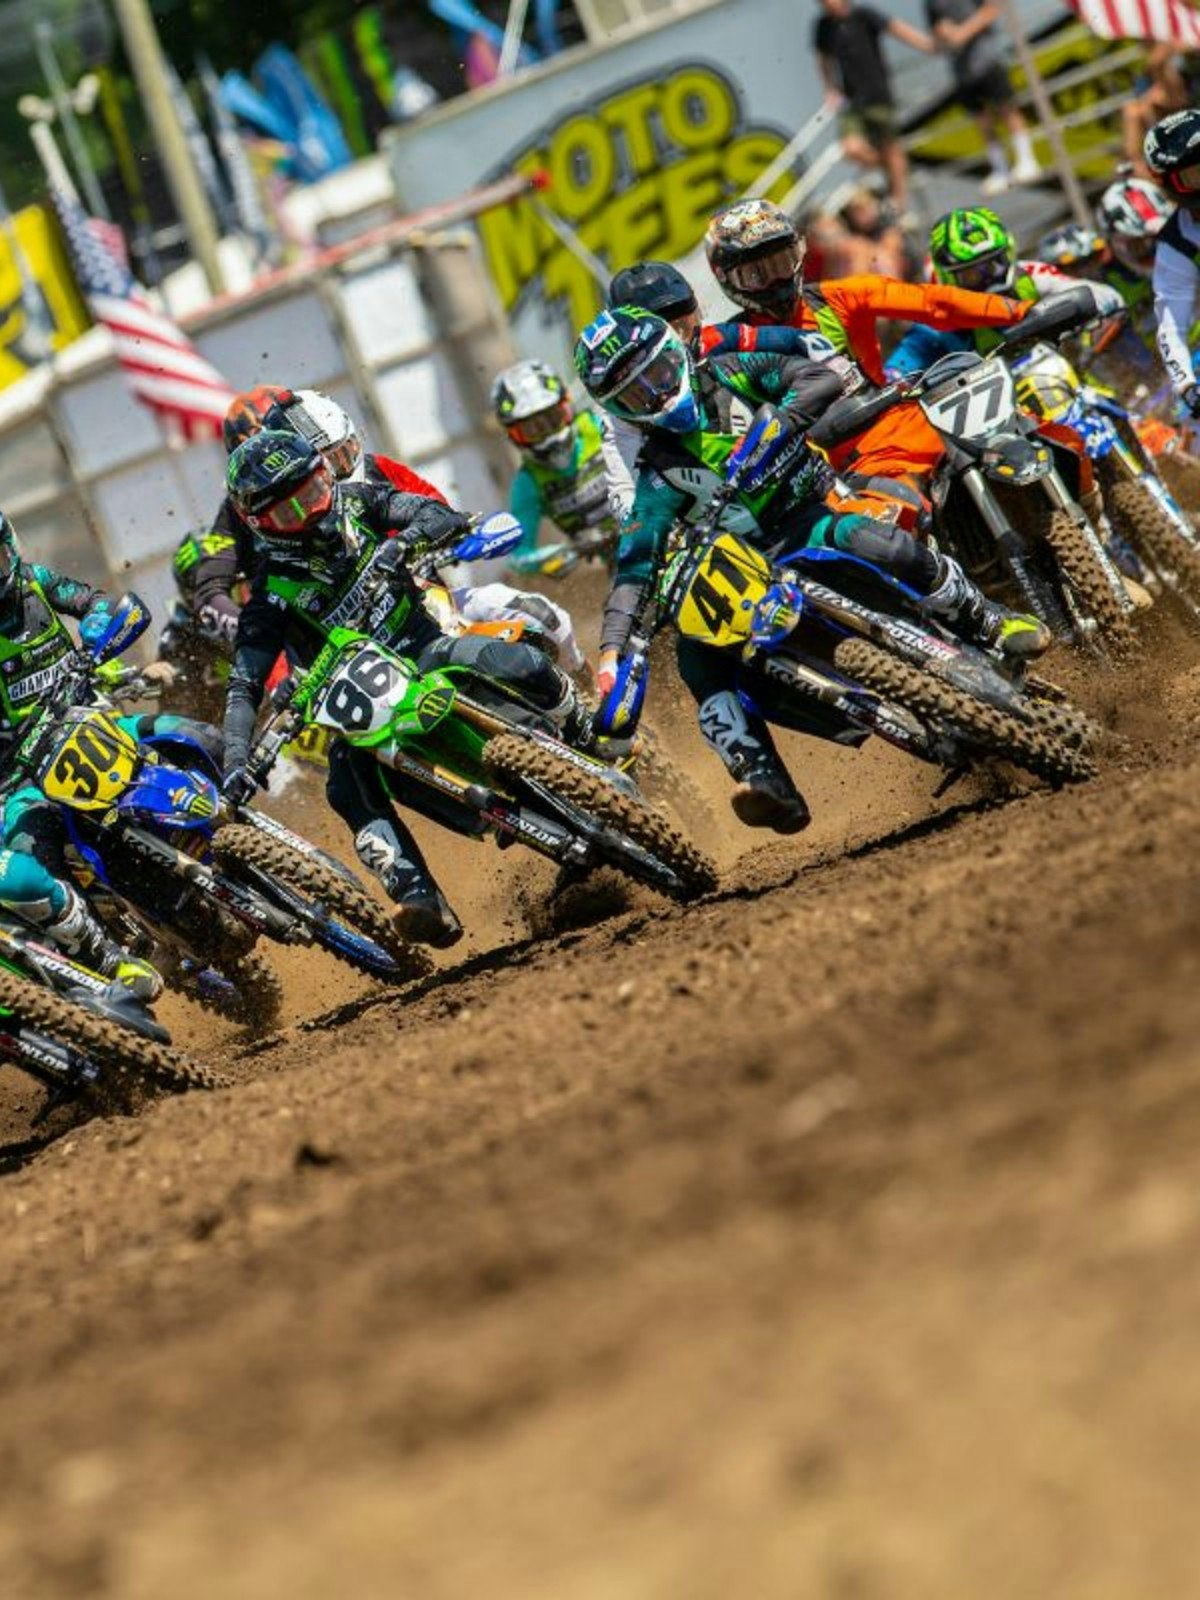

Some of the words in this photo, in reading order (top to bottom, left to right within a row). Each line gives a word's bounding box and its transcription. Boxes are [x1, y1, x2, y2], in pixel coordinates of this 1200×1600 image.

[478, 69, 734, 313] MOTO
[543, 133, 797, 338] TEES
[938, 376, 1004, 437] 77
[689, 544, 751, 637] 41
[325, 650, 399, 731] 86
[55, 723, 121, 800] 30
[504, 812, 560, 847] UNLOP
[193, 875, 267, 921] DULOP
